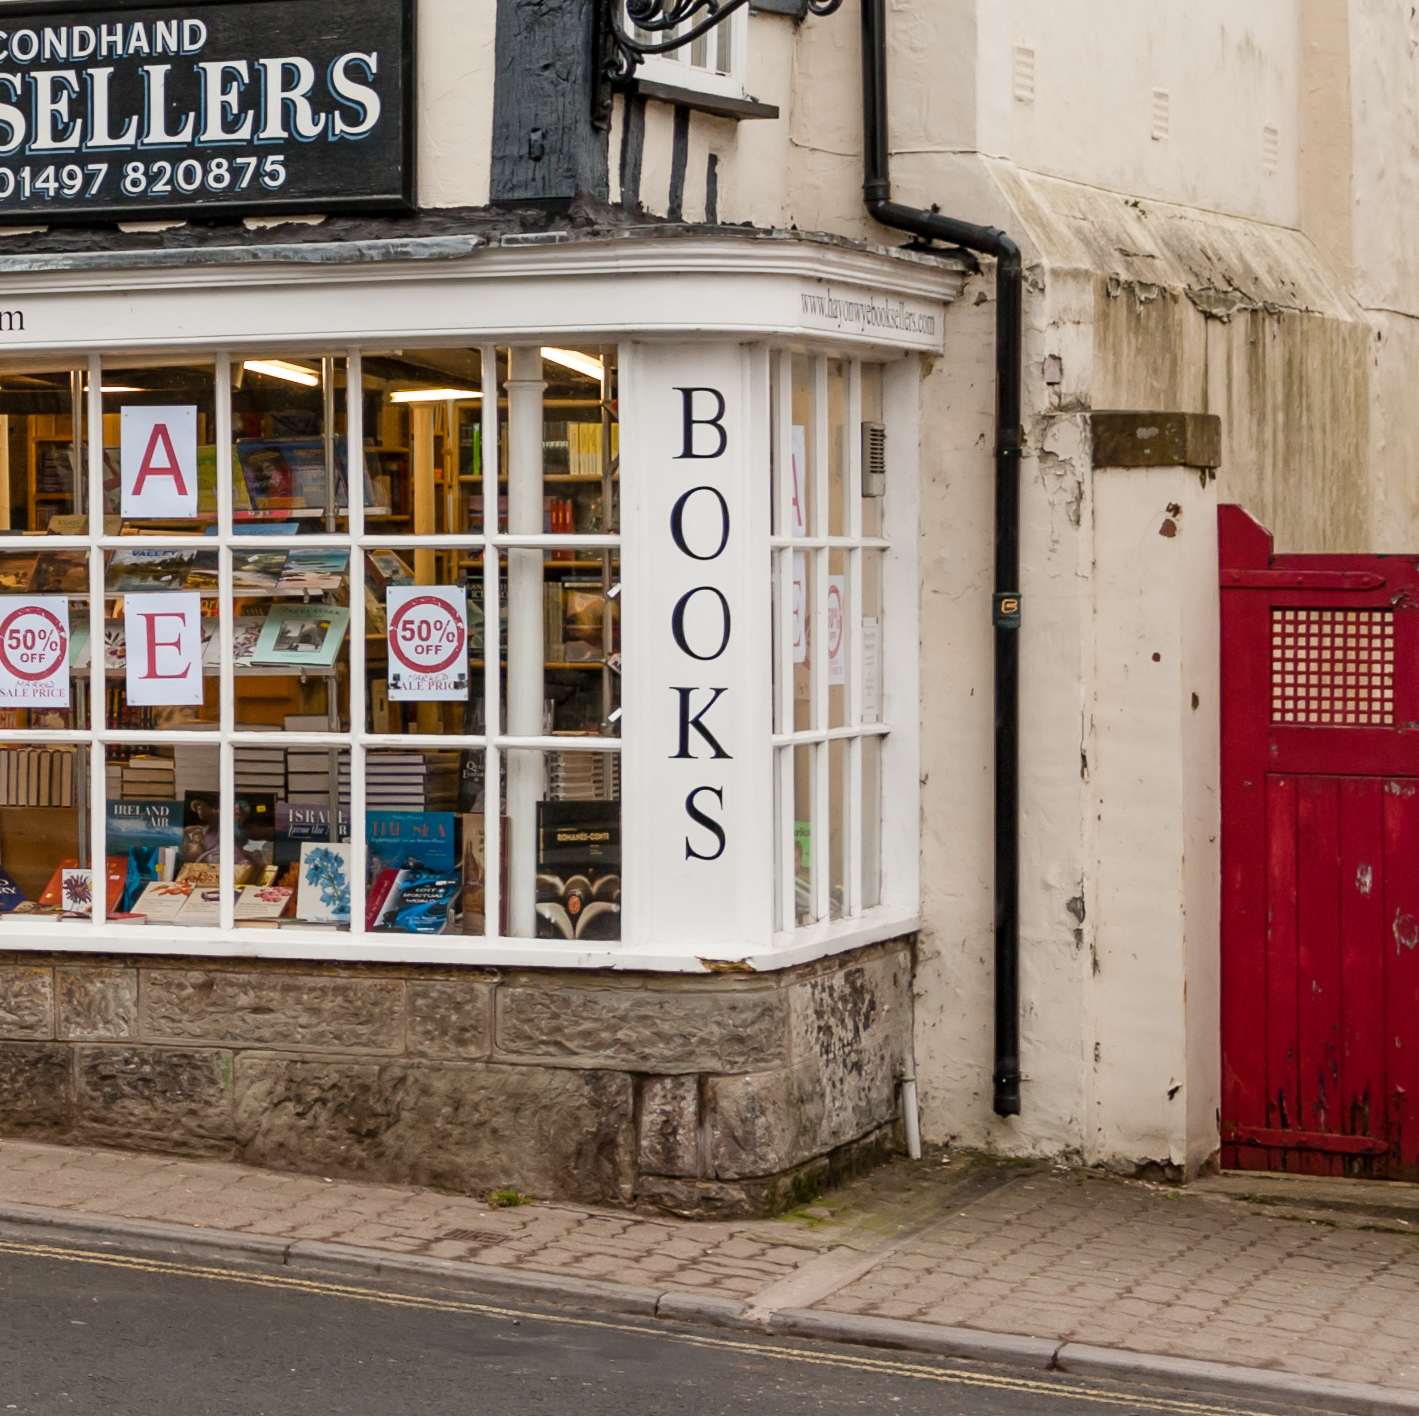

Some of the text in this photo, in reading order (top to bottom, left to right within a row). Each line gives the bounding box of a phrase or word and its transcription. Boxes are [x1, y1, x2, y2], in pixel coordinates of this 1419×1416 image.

[123, 155, 287, 196] 820875
[801, 288, 935, 335] www.hayonwyebooksellers.com
[131, 423, 189, 496] A
[401, 620, 455, 643] 50%
[668, 387, 733, 861] BOOKS
[7, 629, 58, 651] 50%
[137, 612, 191, 680] E
[20, 653, 46, 663] OFF
[415, 645, 442, 655] OFF
[0, 688, 65, 697] SALE PRICE
[398, 681, 425, 691] ALE
[114, 805, 170, 816] IRELAND
[289, 809, 347, 824] ISRAL
[150, 817, 169, 827] AIR
